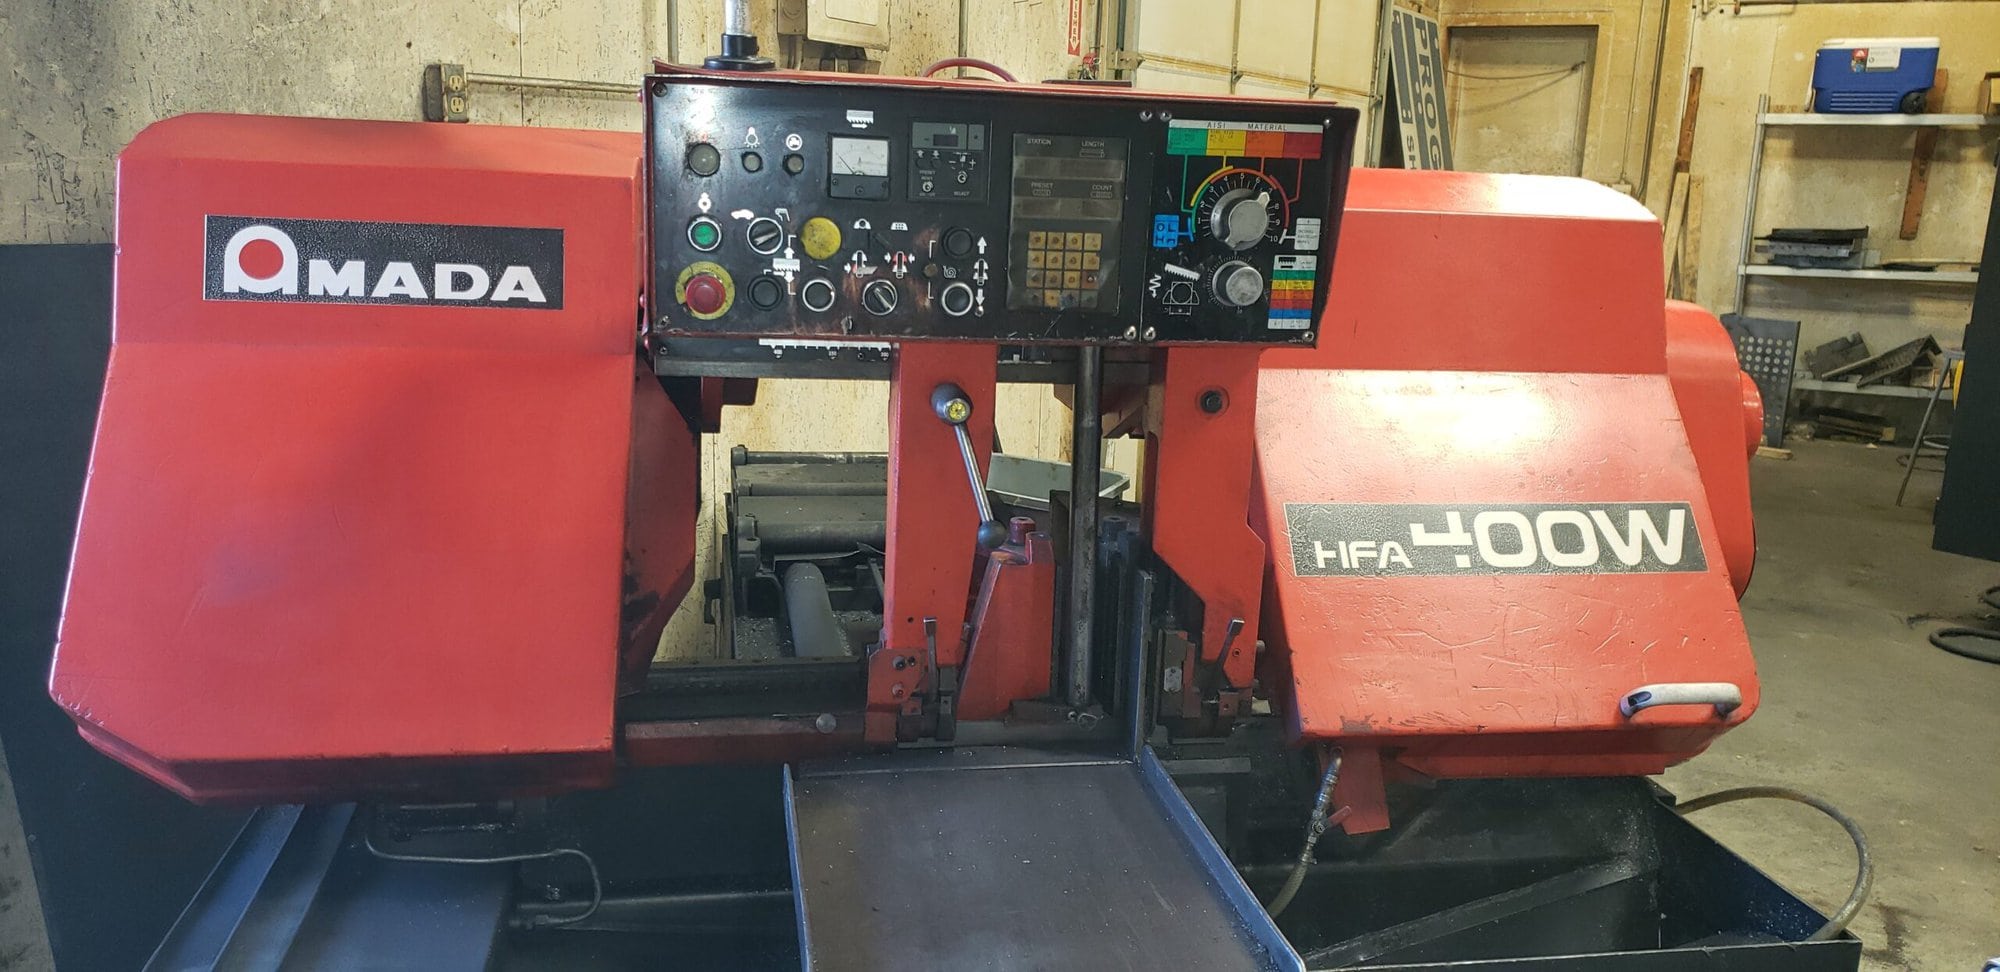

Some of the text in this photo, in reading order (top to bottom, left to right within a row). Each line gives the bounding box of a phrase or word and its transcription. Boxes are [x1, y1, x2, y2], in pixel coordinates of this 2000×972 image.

[224, 226, 547, 302] AMADA
[1314, 509, 1686, 568] HFA 400W
